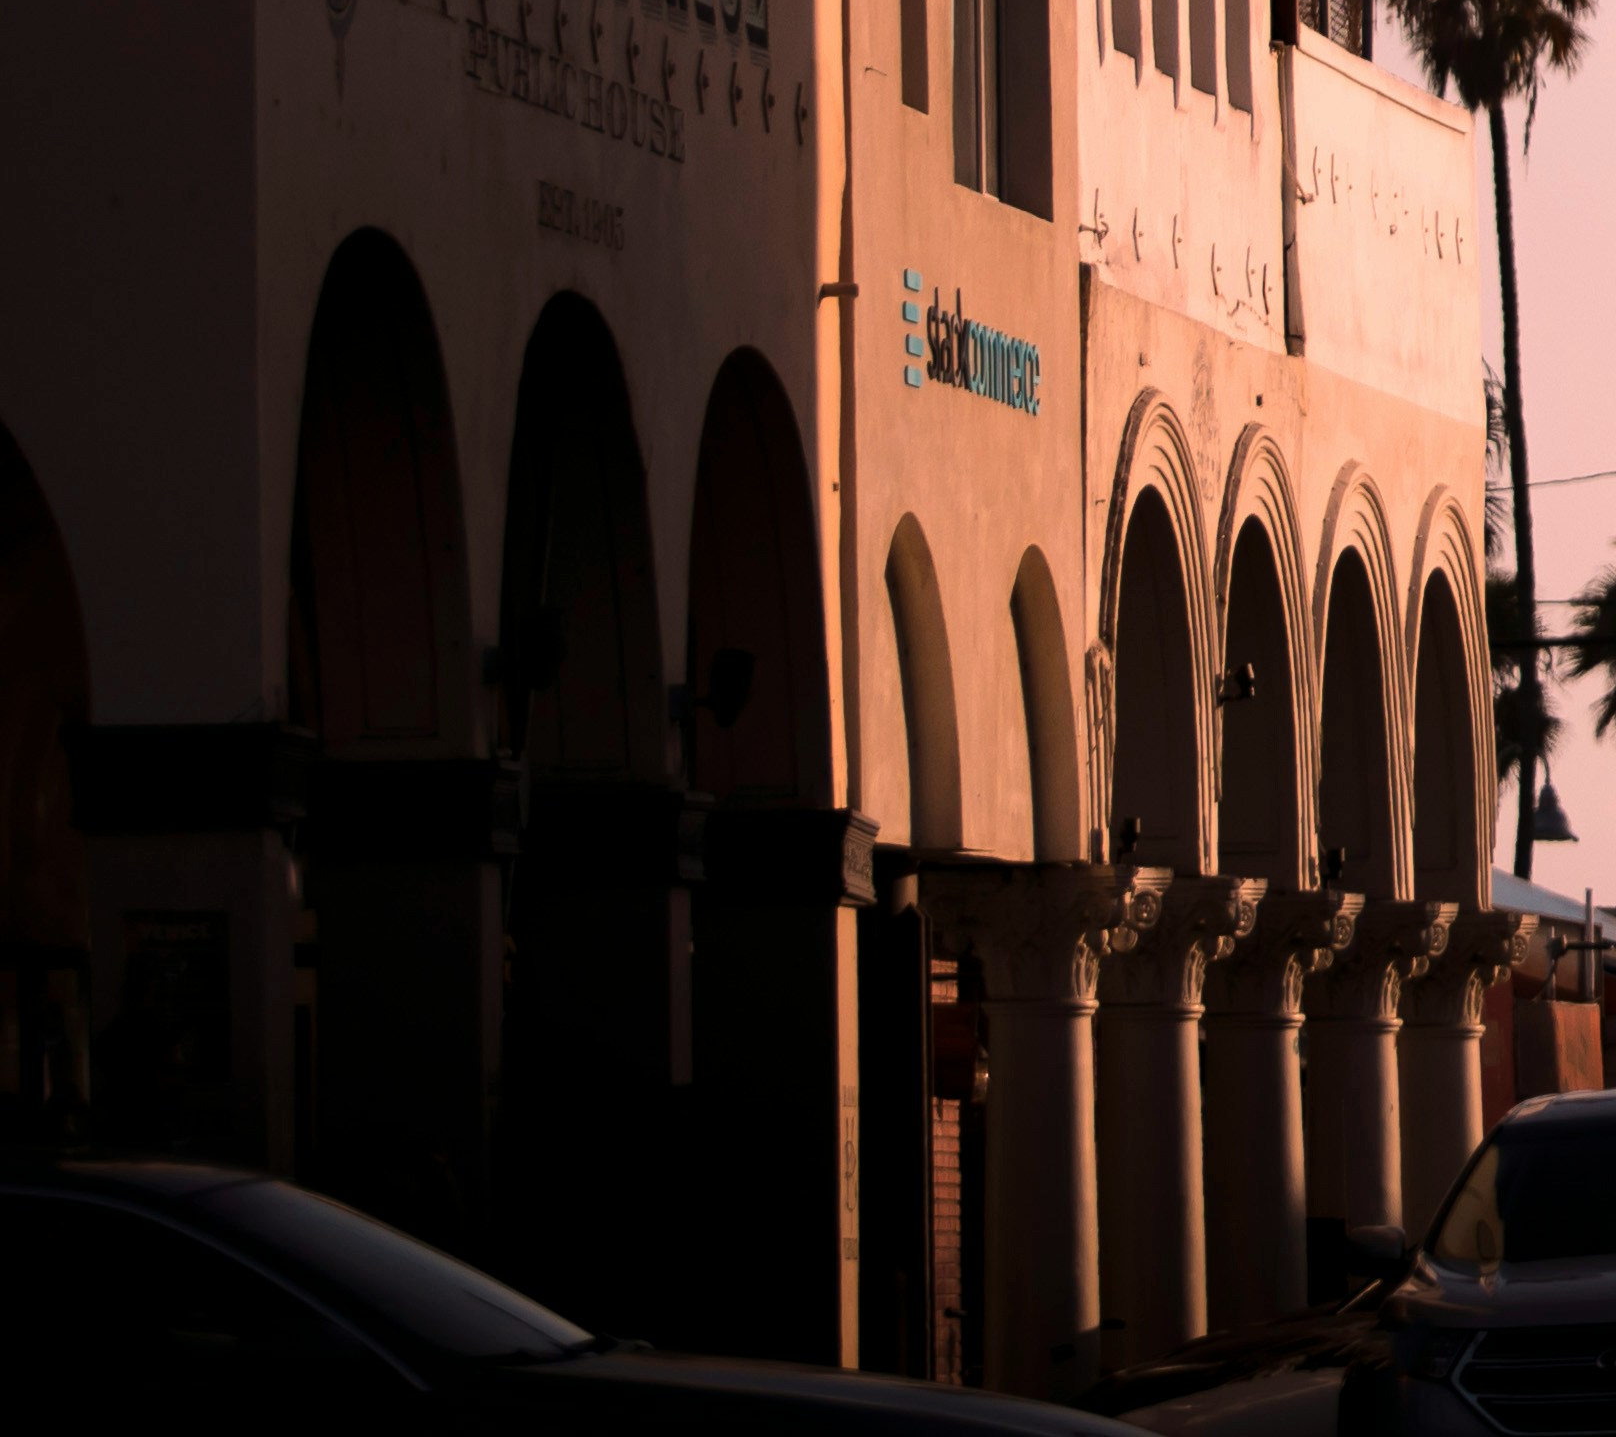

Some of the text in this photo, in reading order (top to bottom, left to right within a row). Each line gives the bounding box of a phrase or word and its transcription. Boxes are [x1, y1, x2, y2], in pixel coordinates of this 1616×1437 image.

[466, 17, 685, 164] PUBLIC HOUSE
[926, 286, 1041, 417] stackcommerce
